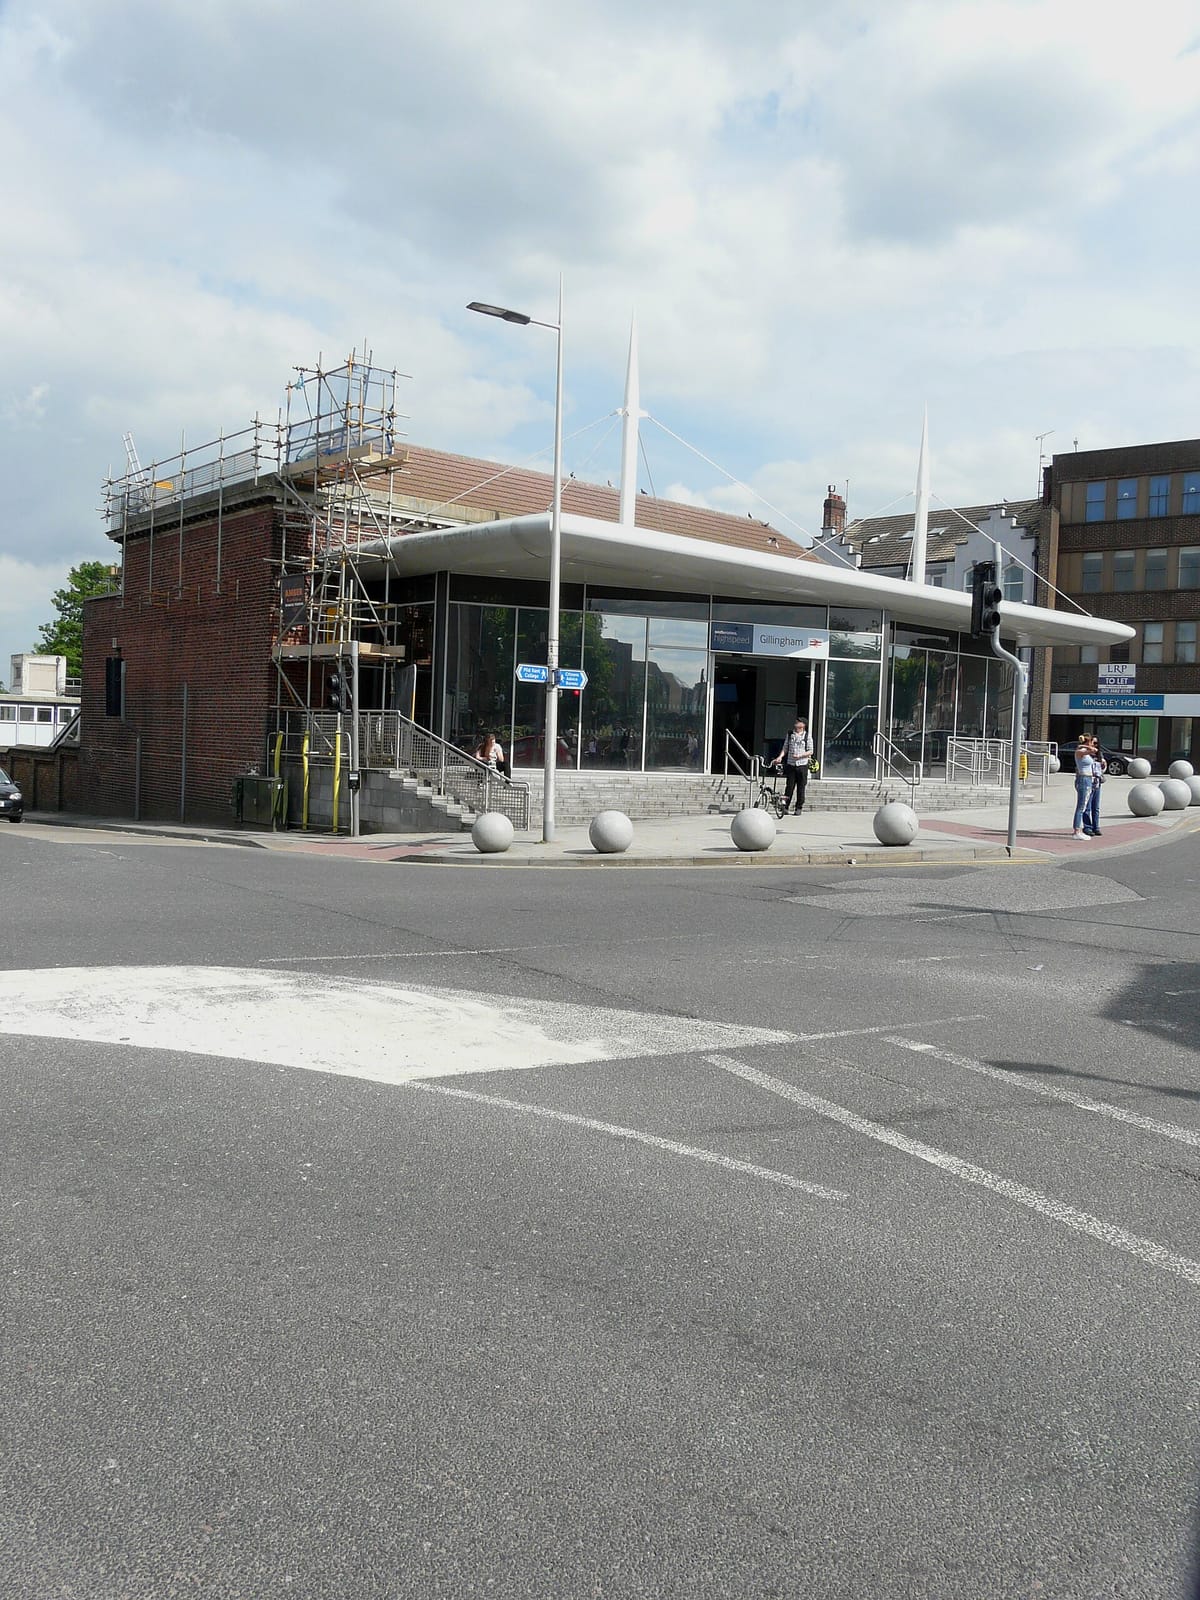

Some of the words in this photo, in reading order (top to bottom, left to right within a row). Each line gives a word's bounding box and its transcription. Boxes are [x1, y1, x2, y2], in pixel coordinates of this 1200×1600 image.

[760, 634, 804, 648] Gillingham
[1107, 665, 1128, 674] LRP
[1121, 699, 1149, 707] HOUSE
